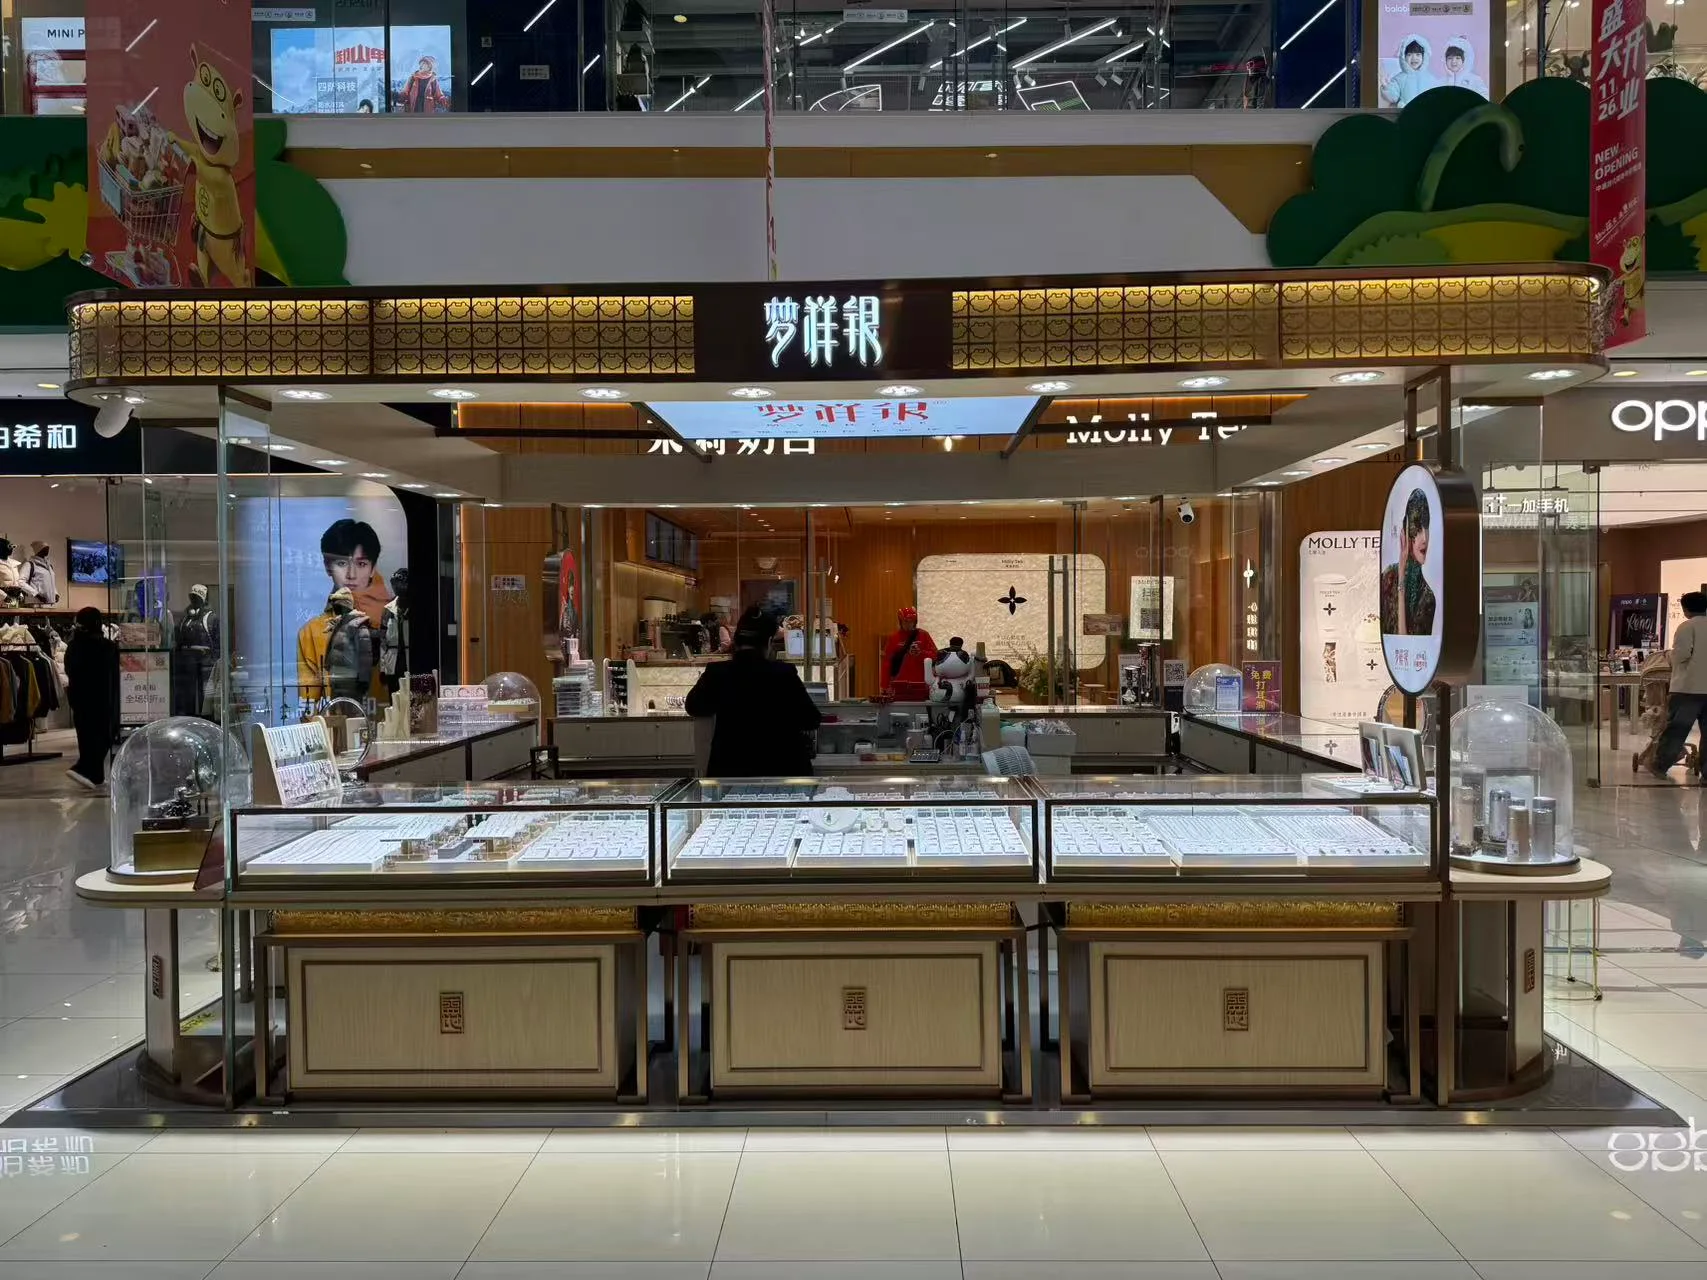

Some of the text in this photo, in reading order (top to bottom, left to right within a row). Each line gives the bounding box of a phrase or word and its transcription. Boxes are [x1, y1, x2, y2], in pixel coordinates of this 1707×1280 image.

[1384, 4, 1409, 13] balab
[47, 29, 74, 38] MINI
[1599, 77, 1617, 100] 11
[1598, 98, 1617, 121] 26
[1594, 142, 1620, 165] NEW
[1594, 147, 1640, 181] OPENING
[763, 294, 884, 369] 梦祥银
[1191, 412, 1248, 441] Te
[1611, 399, 1707, 441] op
[1507, 498, 1569, 513] 一加手机
[1308, 537, 1359, 549] MOLLY
